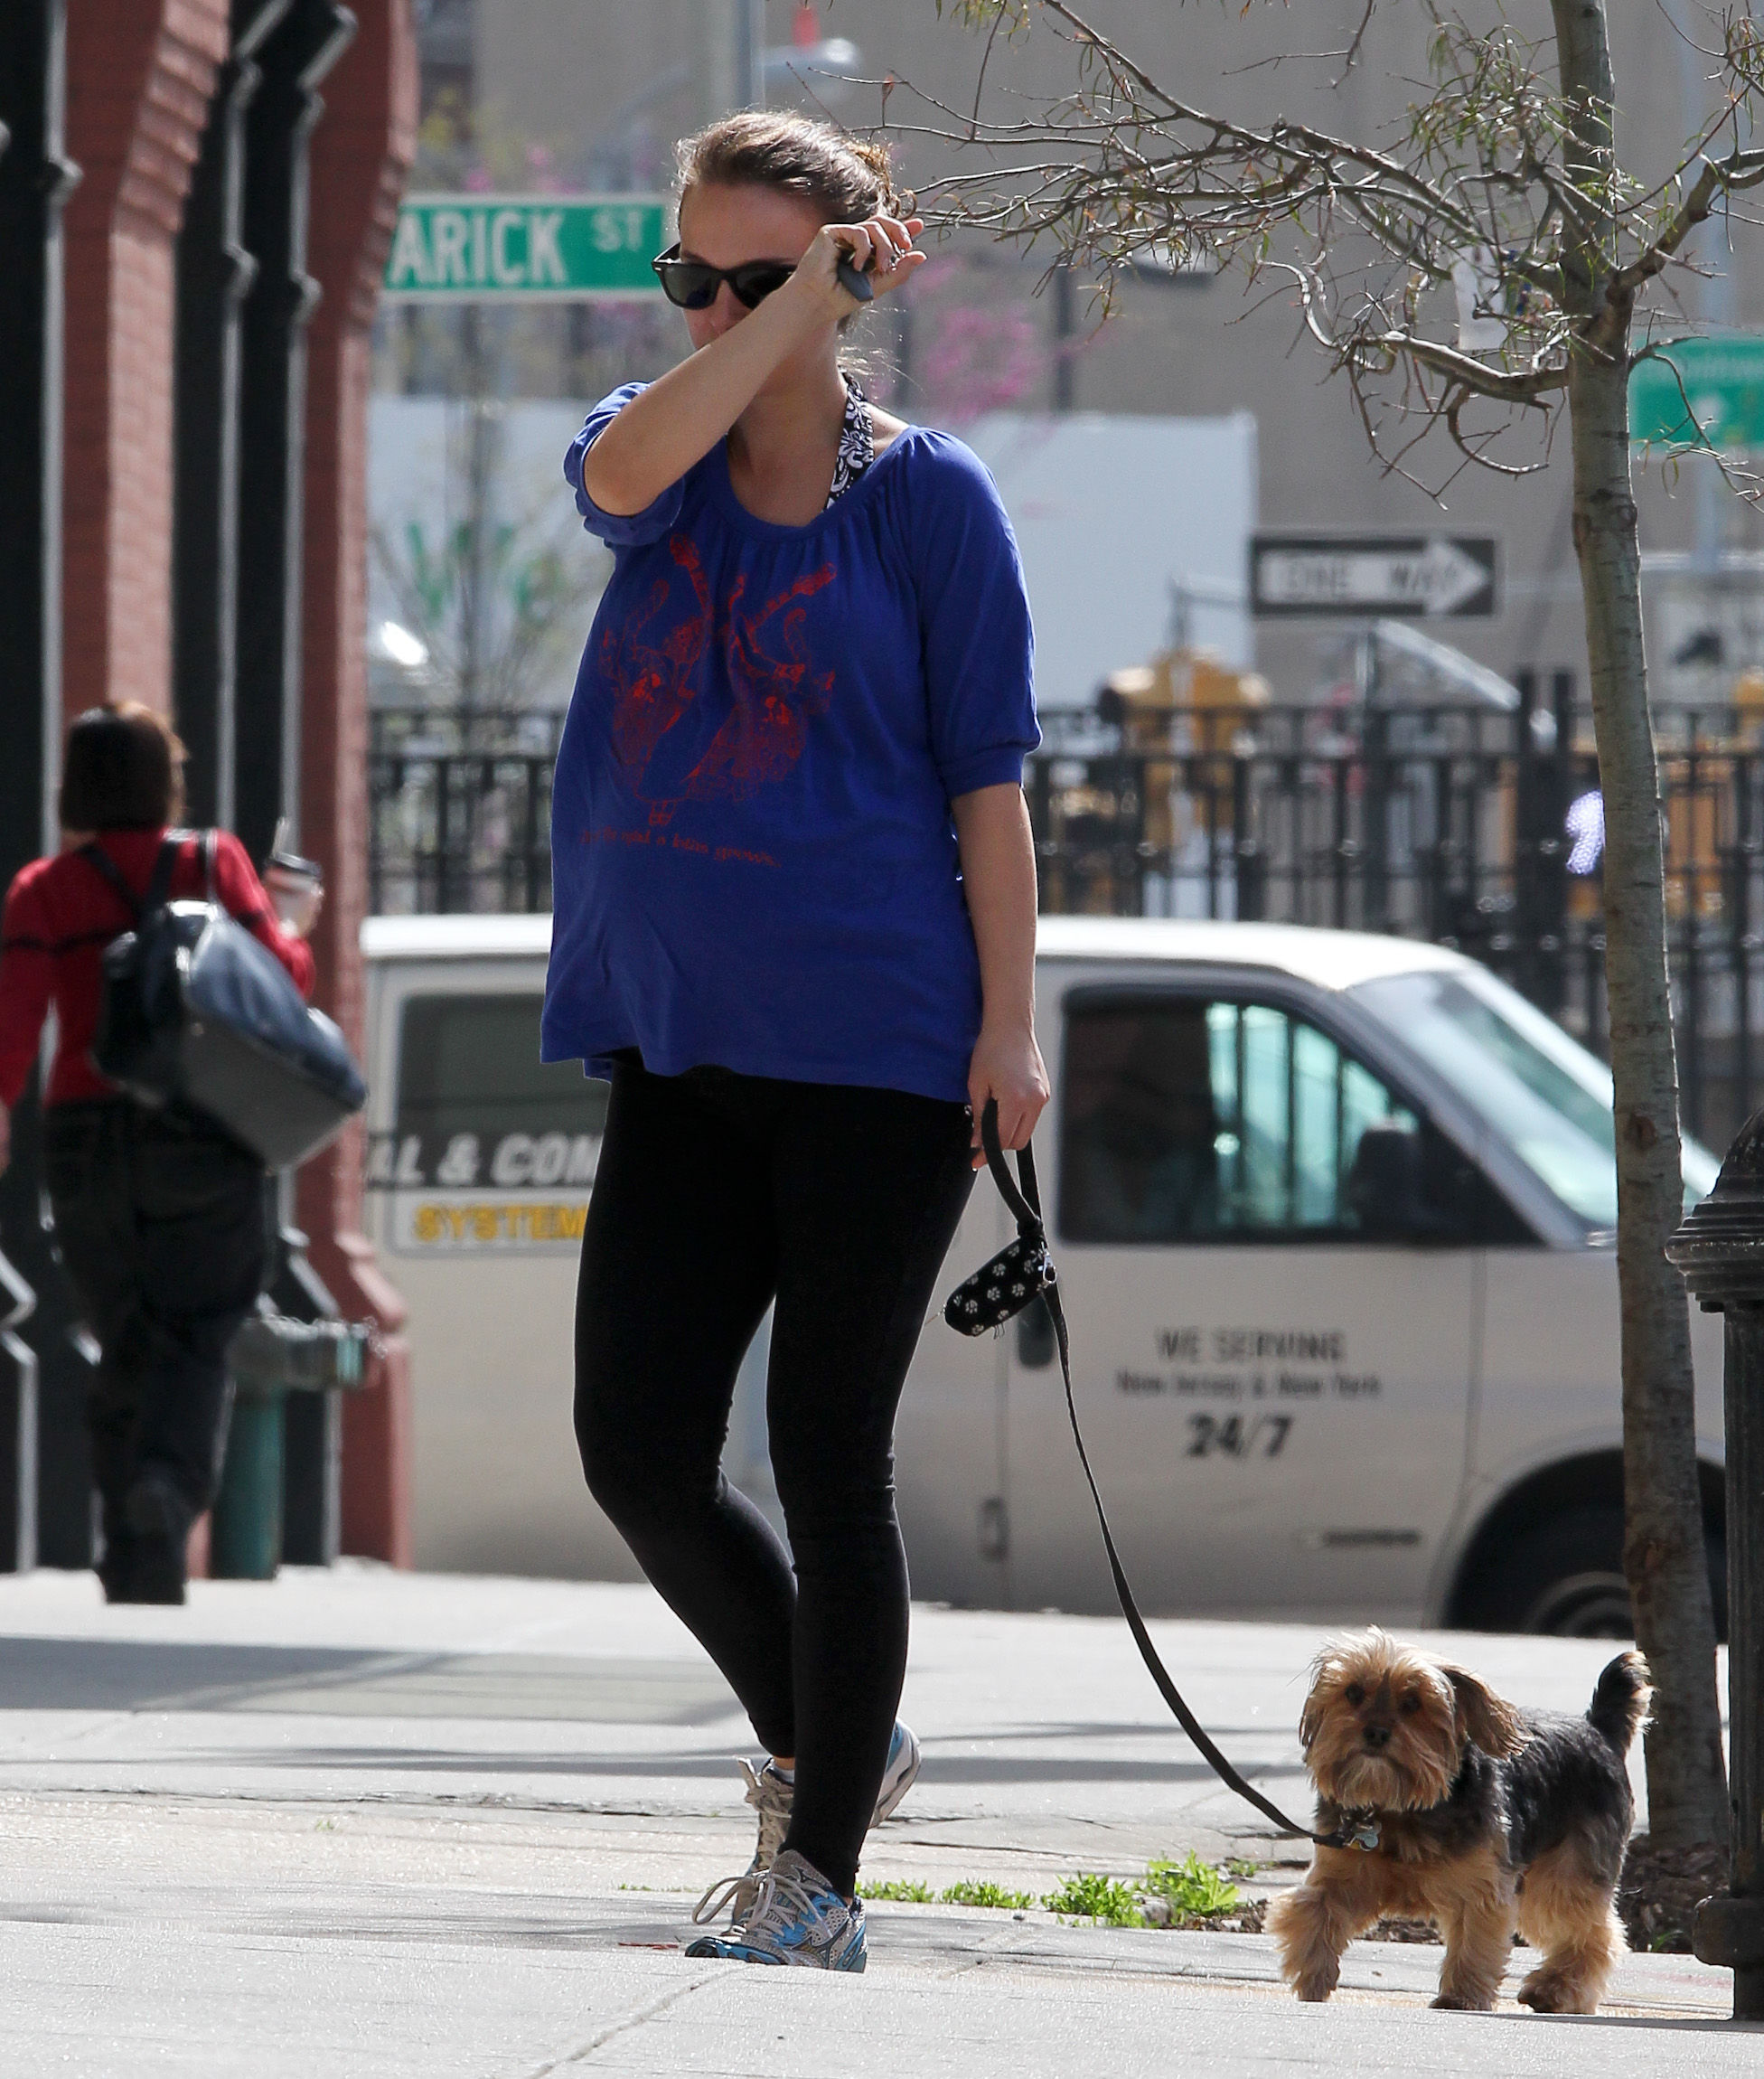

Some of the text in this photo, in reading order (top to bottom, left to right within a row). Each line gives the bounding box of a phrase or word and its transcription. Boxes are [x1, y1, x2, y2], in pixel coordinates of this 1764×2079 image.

[592, 210, 644, 252] ST
[1281, 552, 1348, 598] ONE
[437, 1132, 479, 1185] &
[1157, 1327, 1344, 1361] WE SERVING
[1186, 1412, 1294, 1458] 24/7
